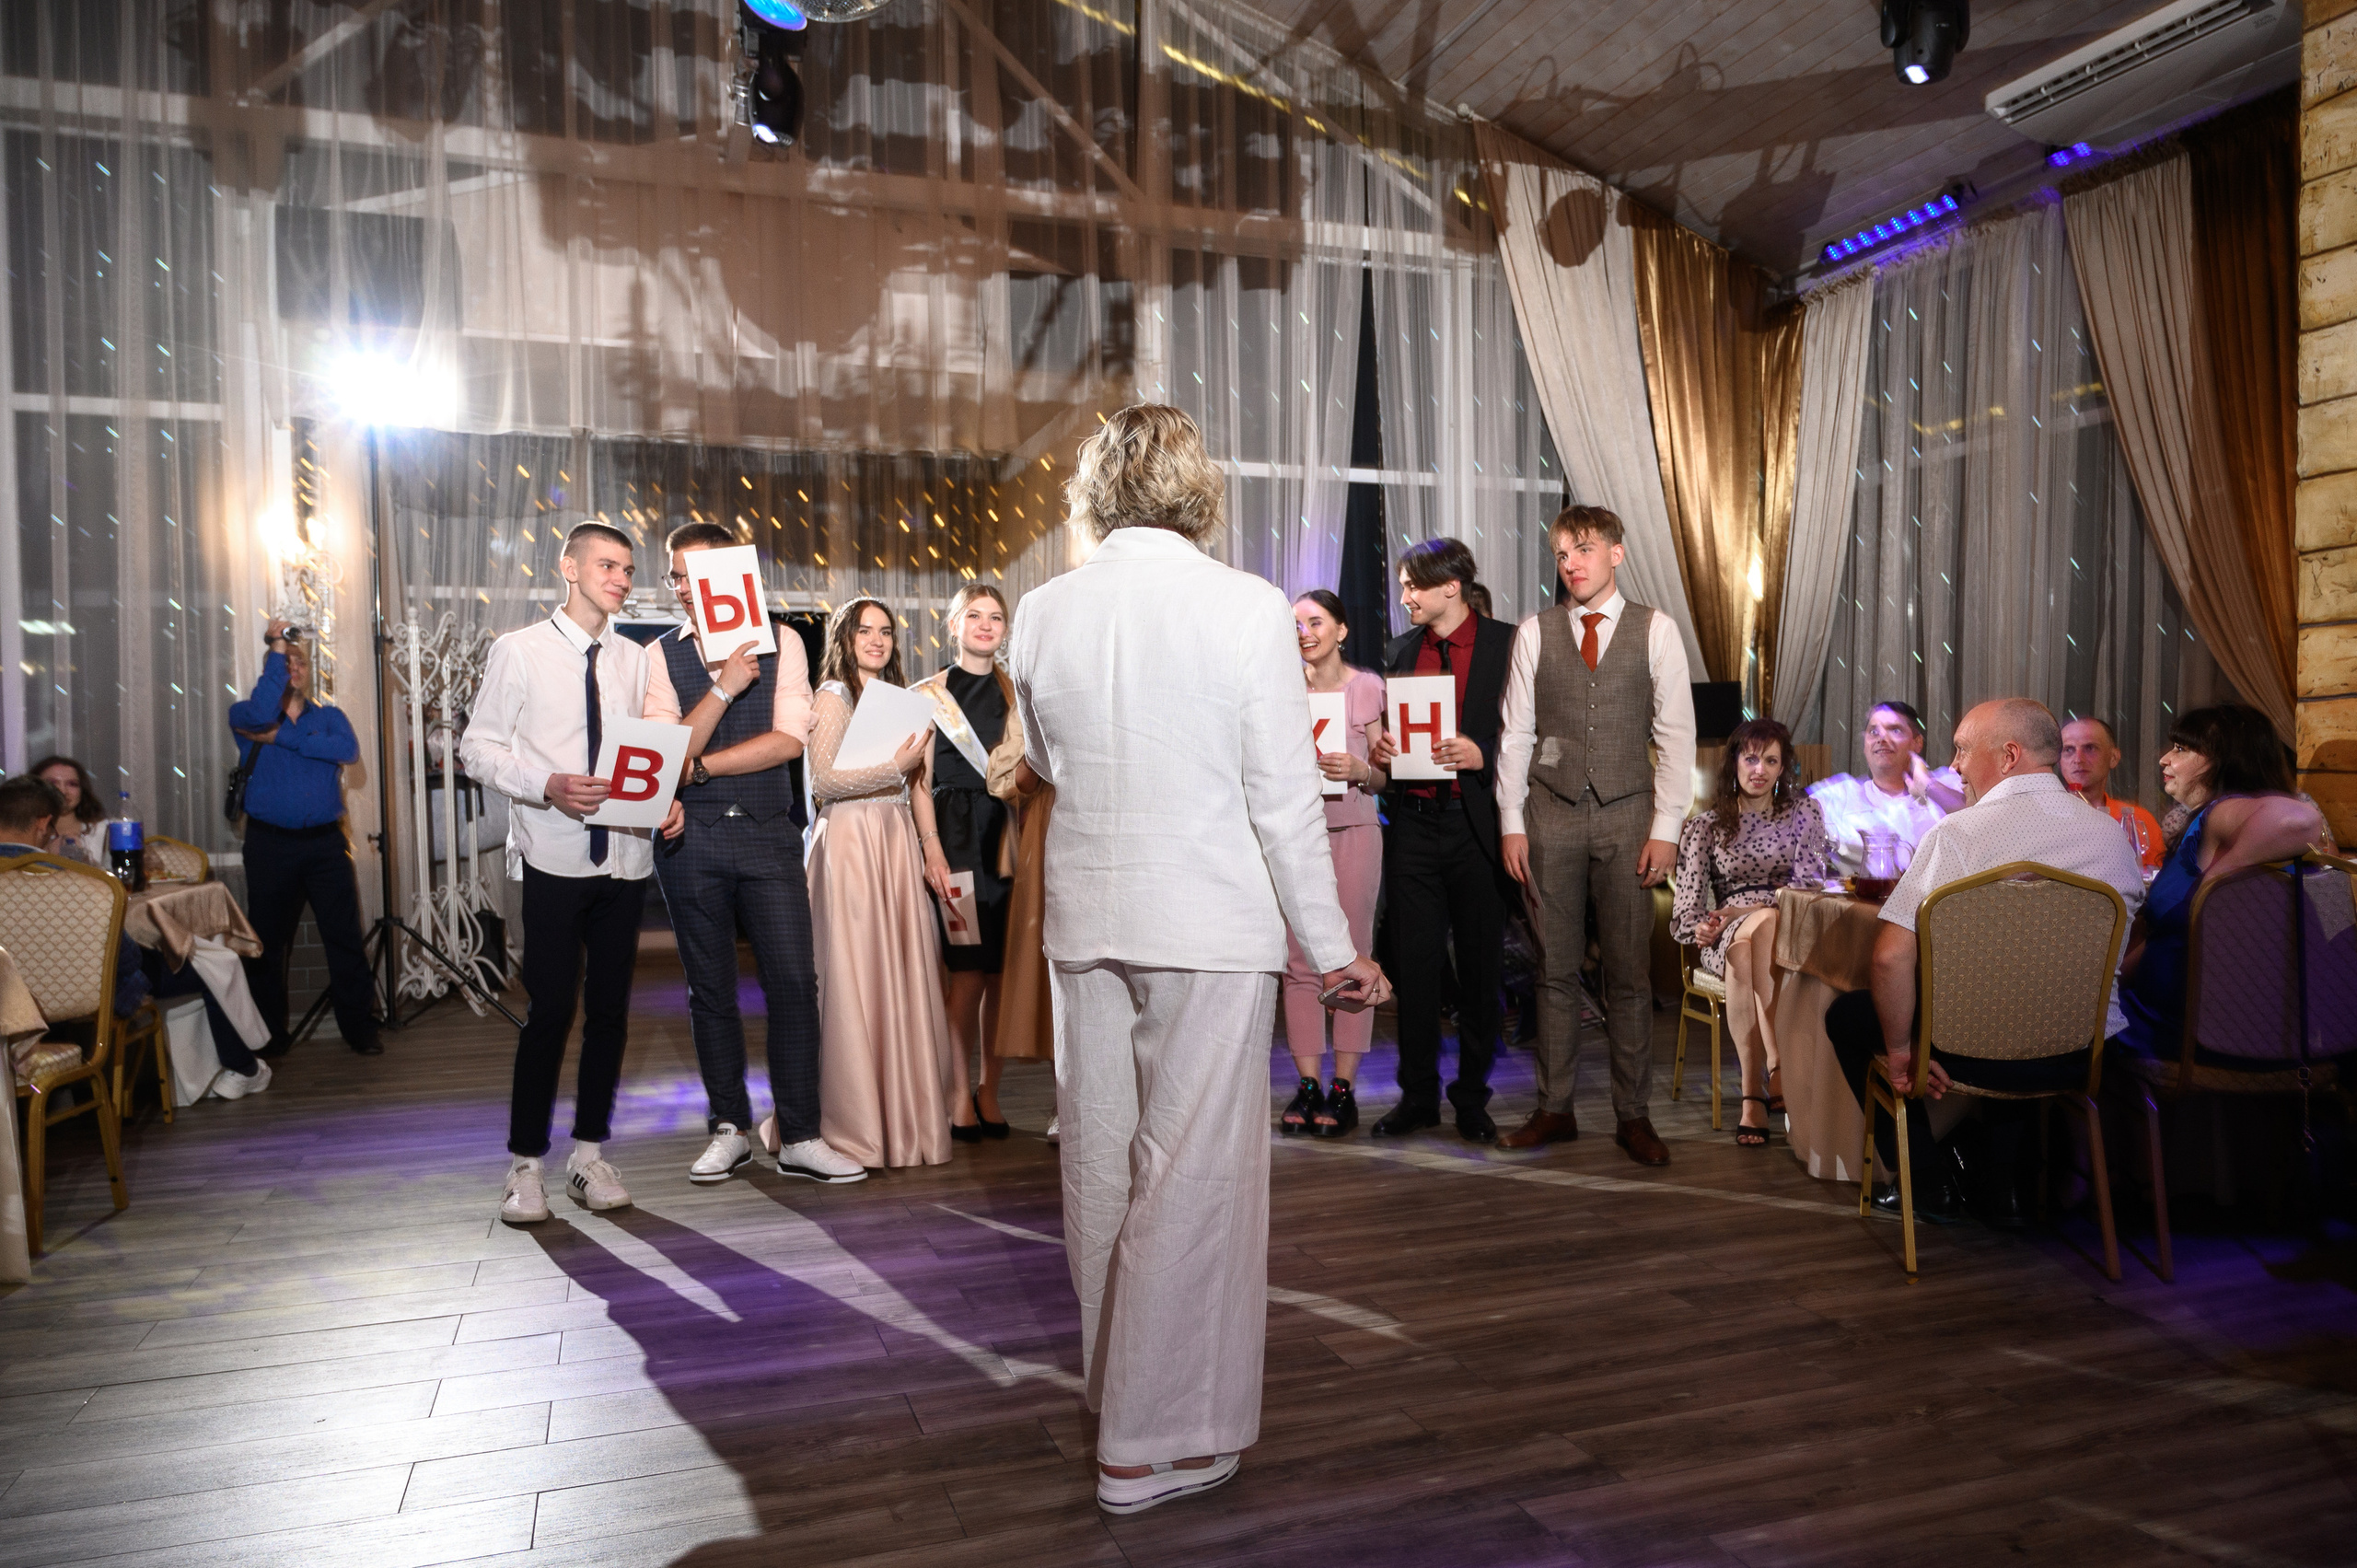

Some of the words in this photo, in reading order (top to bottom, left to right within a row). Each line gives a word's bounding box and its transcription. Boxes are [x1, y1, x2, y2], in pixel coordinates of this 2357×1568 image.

[698, 574, 762, 633] Ы
[1399, 702, 1442, 753] Н
[609, 744, 664, 802] В
